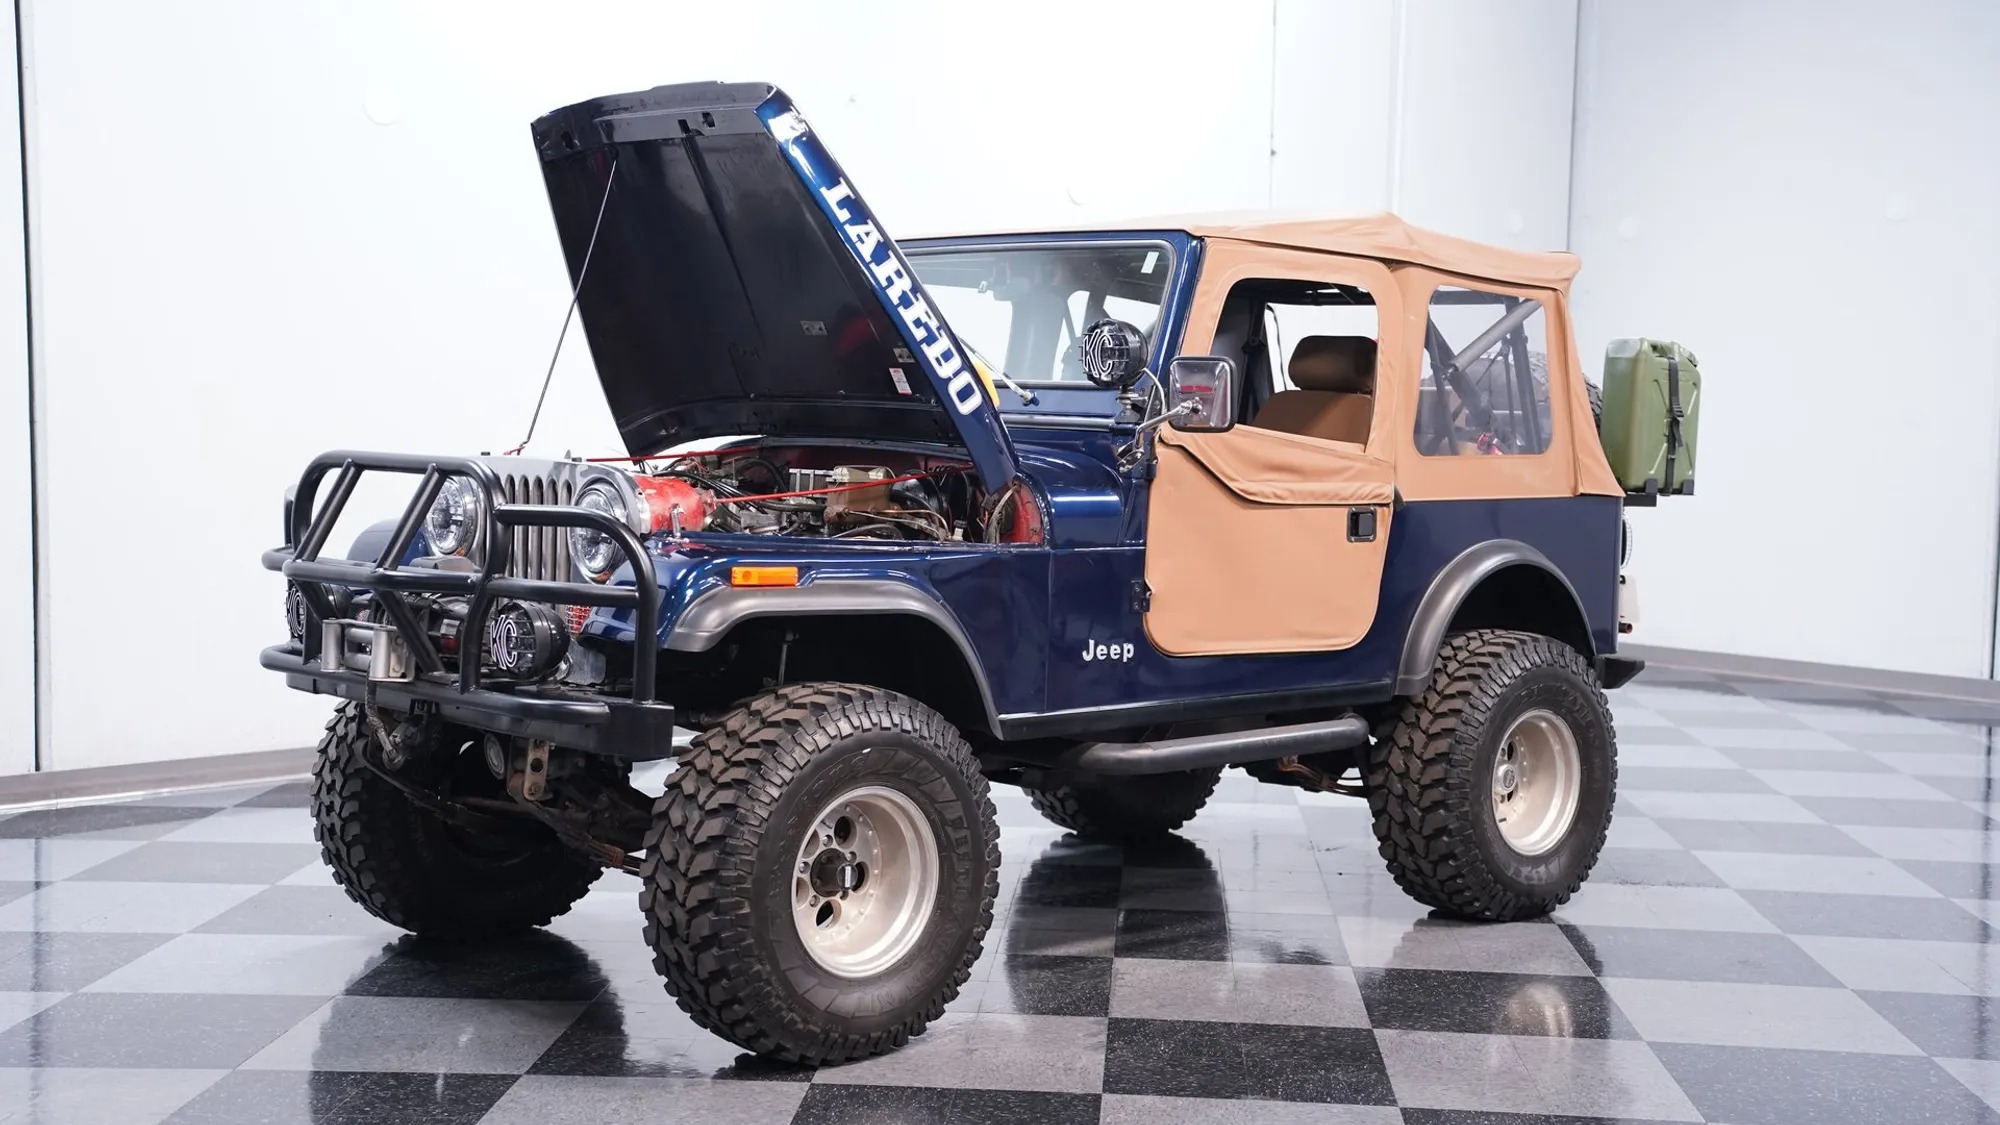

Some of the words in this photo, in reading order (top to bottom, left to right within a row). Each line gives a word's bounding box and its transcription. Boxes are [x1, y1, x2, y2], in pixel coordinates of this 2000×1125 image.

[820, 177, 982, 415] LAREDO
[1083, 329, 1113, 378] KC
[490, 614, 517, 670] KC
[1082, 639, 1135, 662] Jeep
